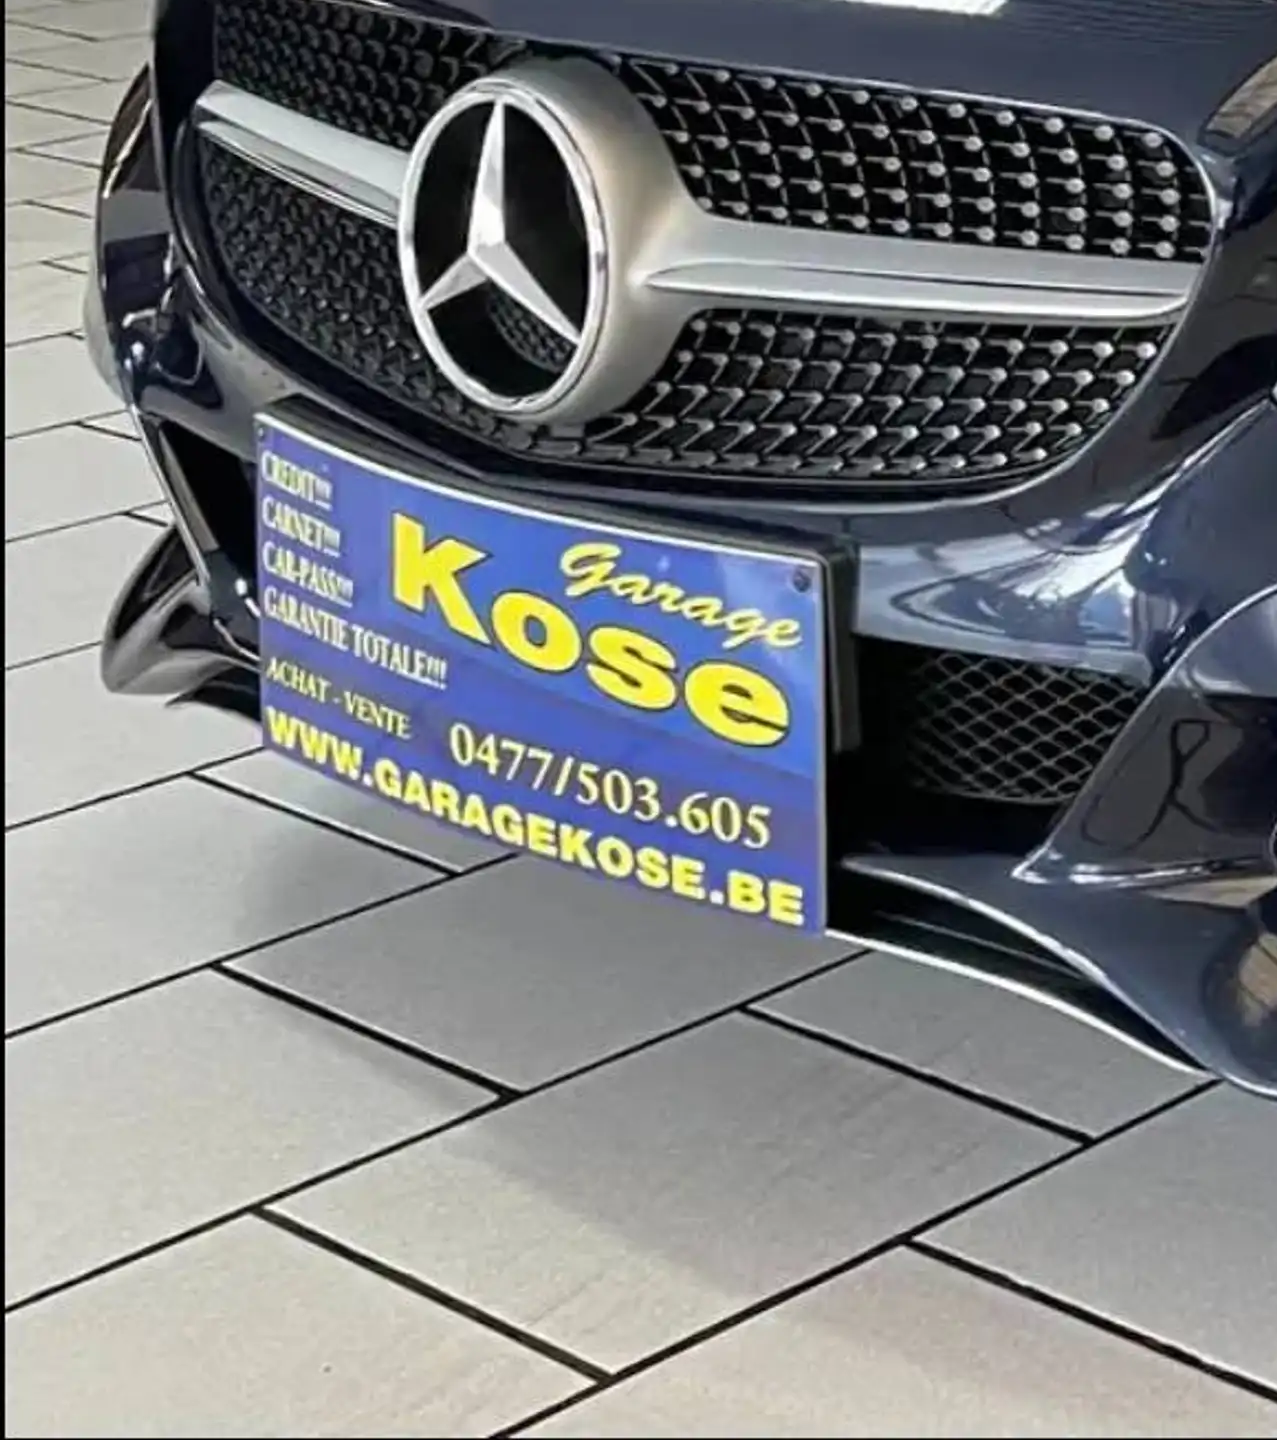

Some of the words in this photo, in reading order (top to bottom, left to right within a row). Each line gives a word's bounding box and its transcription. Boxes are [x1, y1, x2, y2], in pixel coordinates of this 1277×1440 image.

[264, 586, 349, 652] GARANTIE
[391, 511, 792, 748] Kose
[559, 542, 803, 648] Garage
[266, 657, 332, 703] ACHAT
[343, 690, 413, 740] VENTE
[266, 705, 805, 926] WWW.GARAGEKOSE.BE
[449, 722, 772, 849] 0477/503.605
